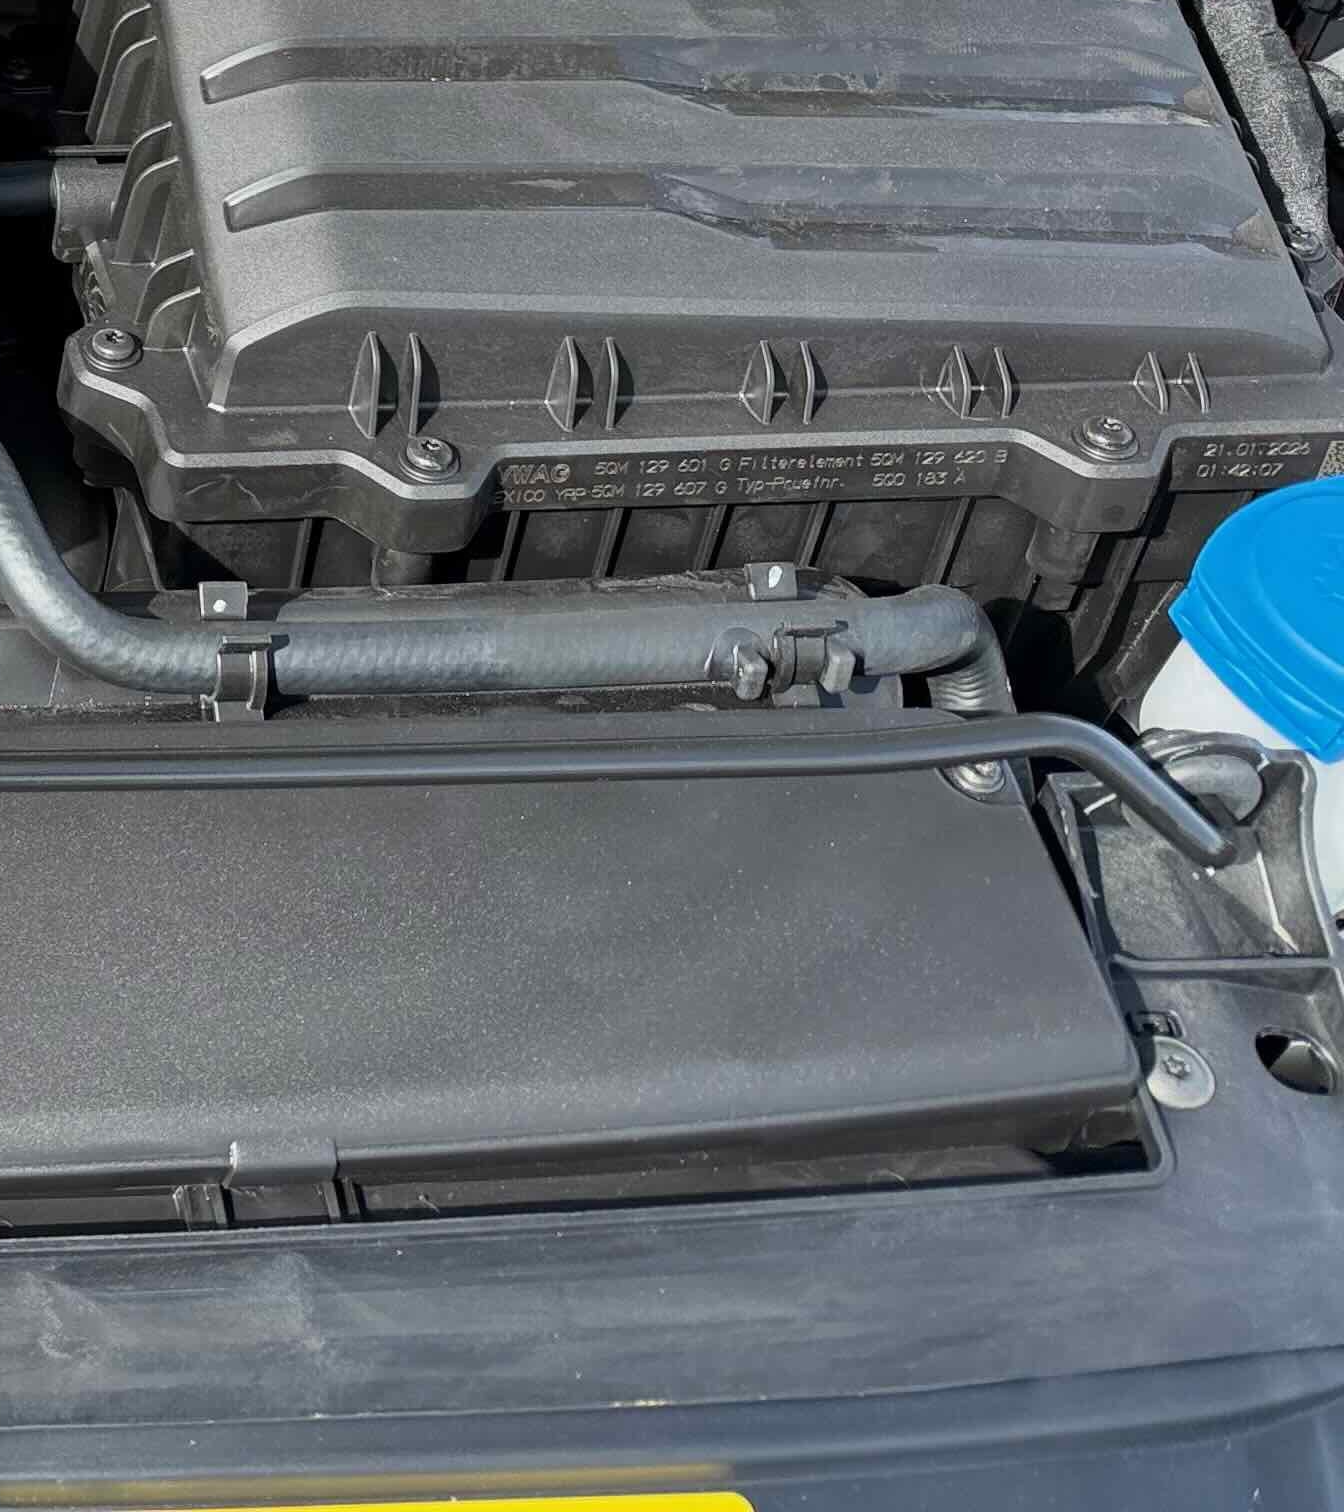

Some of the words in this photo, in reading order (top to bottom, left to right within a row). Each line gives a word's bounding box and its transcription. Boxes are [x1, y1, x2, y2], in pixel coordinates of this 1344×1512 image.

[498, 463, 571, 485] VWAG
[638, 459, 670, 474] 129
[677, 458, 707, 473] 601
[914, 451, 946, 465] 129
[635, 482, 665, 497] 129
